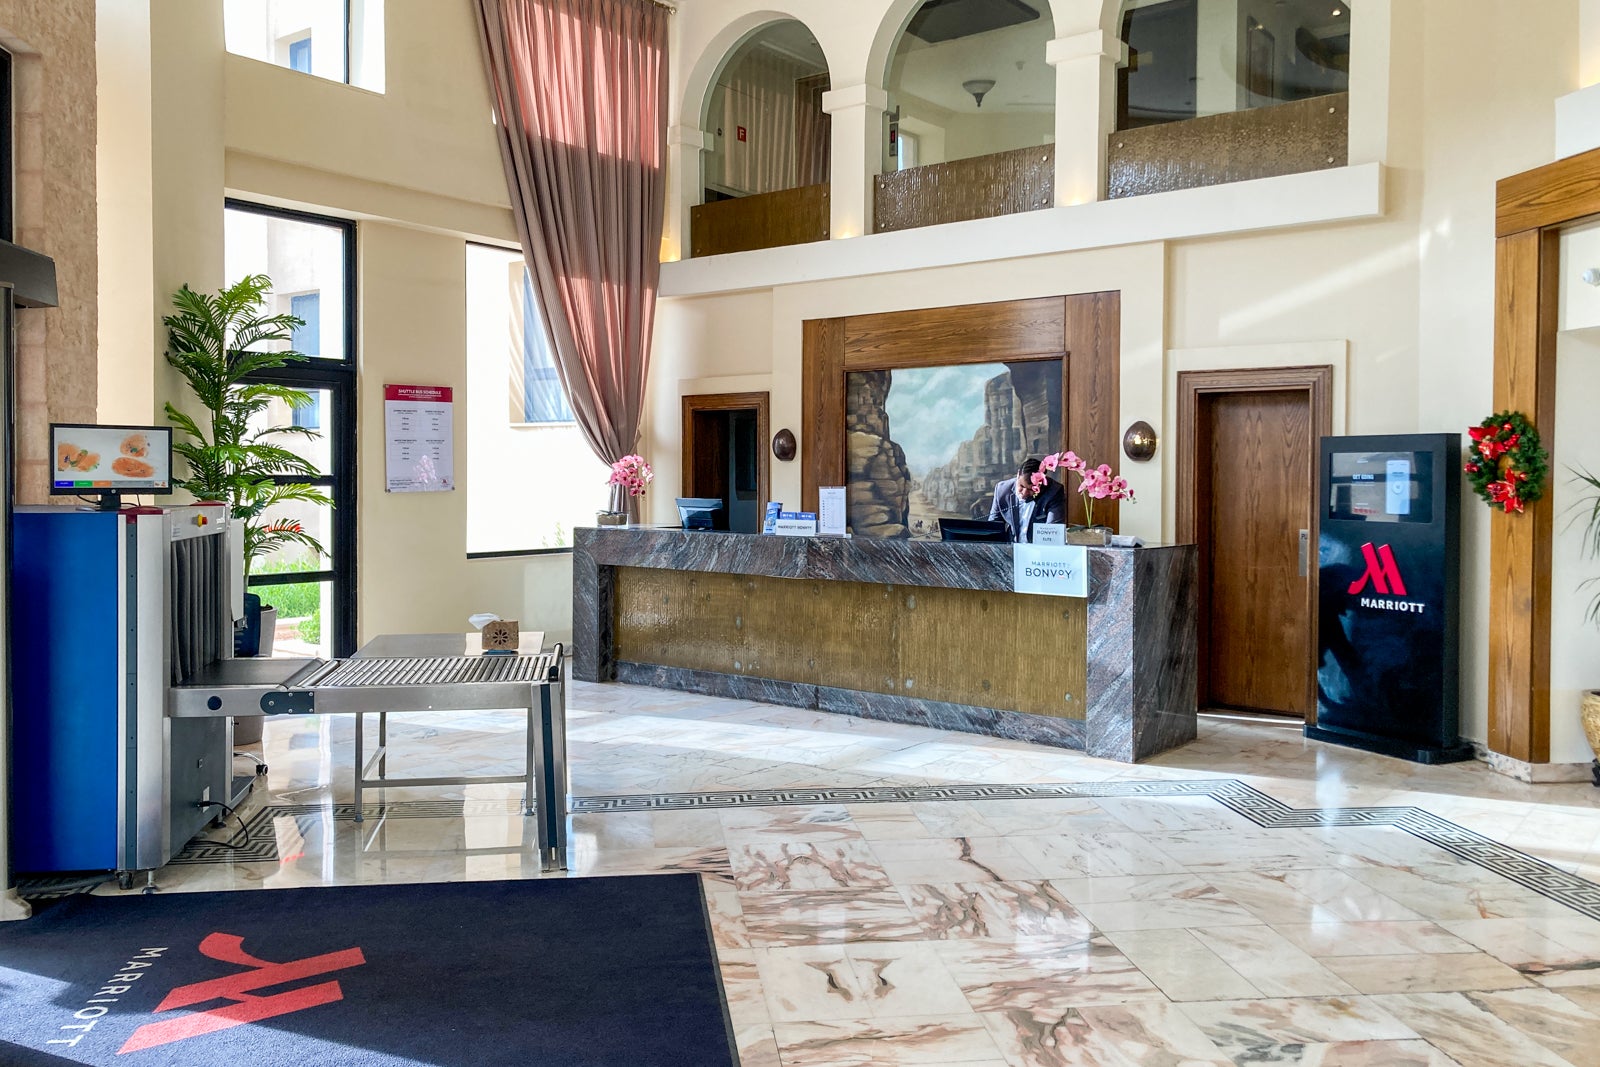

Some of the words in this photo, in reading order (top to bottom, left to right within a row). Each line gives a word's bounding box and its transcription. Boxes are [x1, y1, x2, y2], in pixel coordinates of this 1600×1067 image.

[1025, 567, 1072, 579] BONVOY
[1360, 598, 1425, 613] MARRIOTT
[46, 946, 168, 1047] MARRIOTT
